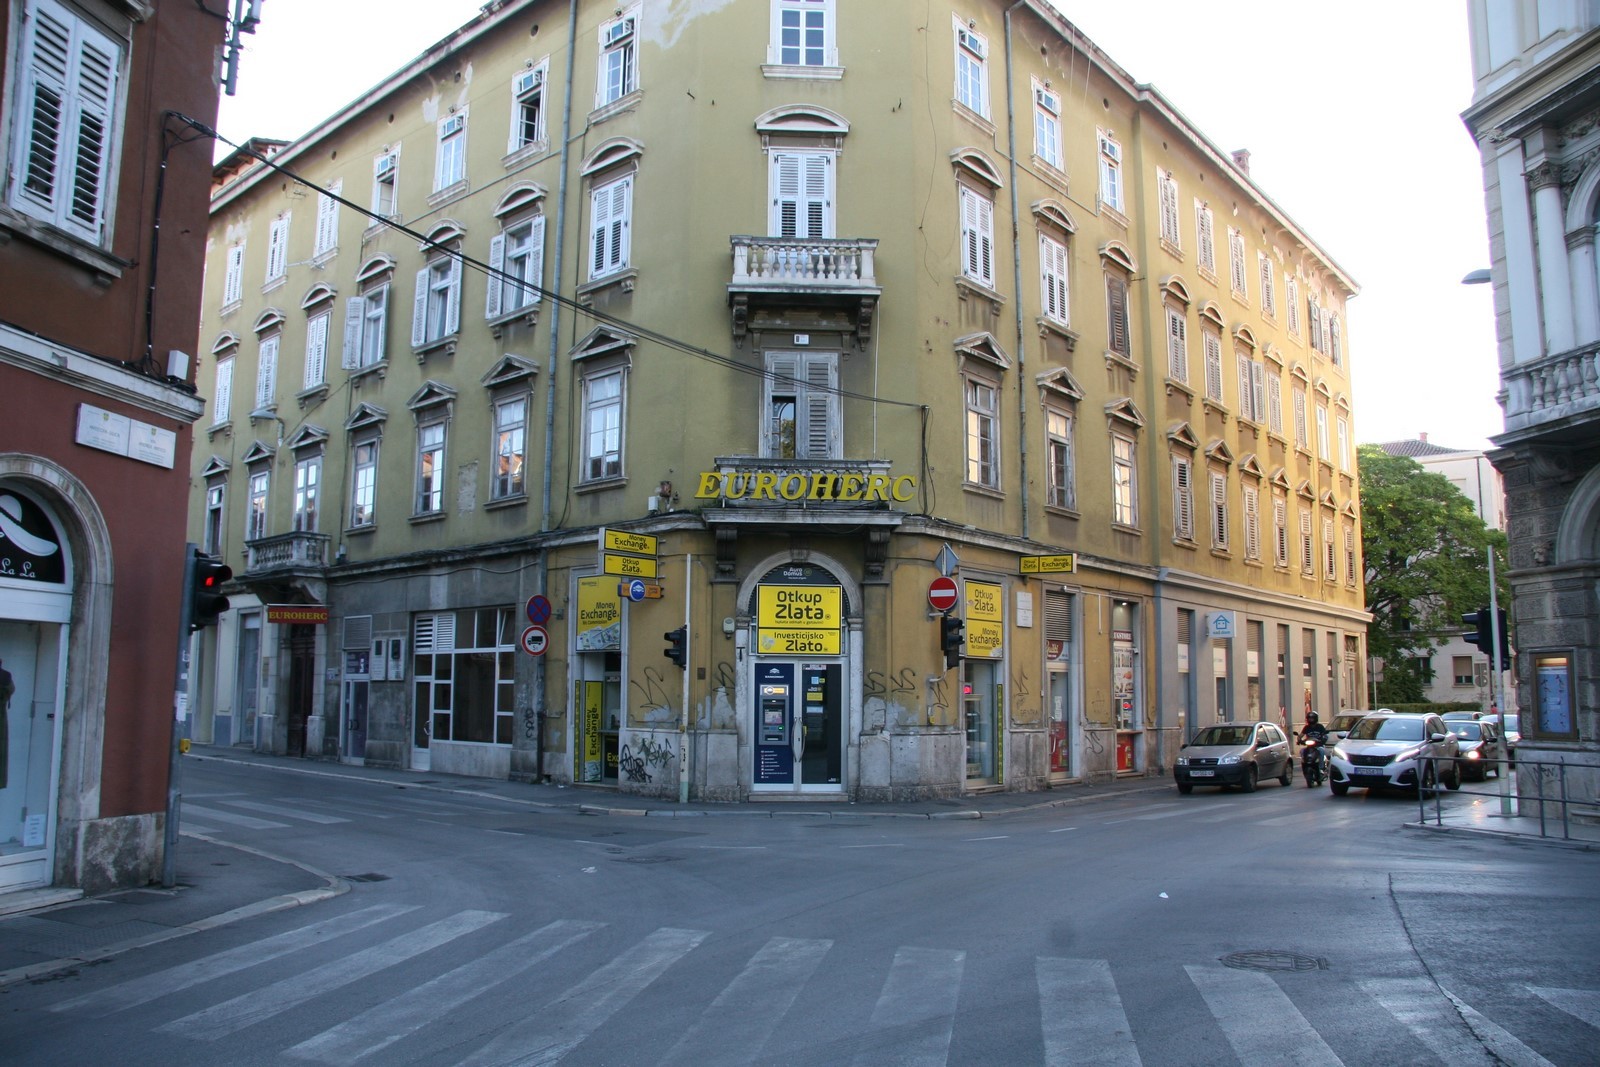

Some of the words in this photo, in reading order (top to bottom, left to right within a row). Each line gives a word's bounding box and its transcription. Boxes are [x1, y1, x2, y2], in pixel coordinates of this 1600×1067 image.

[694, 471, 917, 502] EUROHERC
[614, 537, 648, 550] Exchange
[629, 534, 646, 543] Money
[622, 557, 640, 566] Otkup
[621, 564, 640, 573] Zlata
[777, 590, 822, 606] Otkup
[974, 588, 994, 602] Otkup
[596, 601, 616, 609] Money
[775, 603, 824, 620] Zlata
[974, 599, 995, 612] Zlata
[268, 611, 328, 620] EUROHERC
[580, 608, 617, 621] Exchange
[774, 631, 824, 640] Investicijsko
[982, 627, 999, 638] Money
[785, 639, 823, 652] Zlato
[969, 633, 1000, 648] Exchange
[589, 707, 599, 756] Exchange
